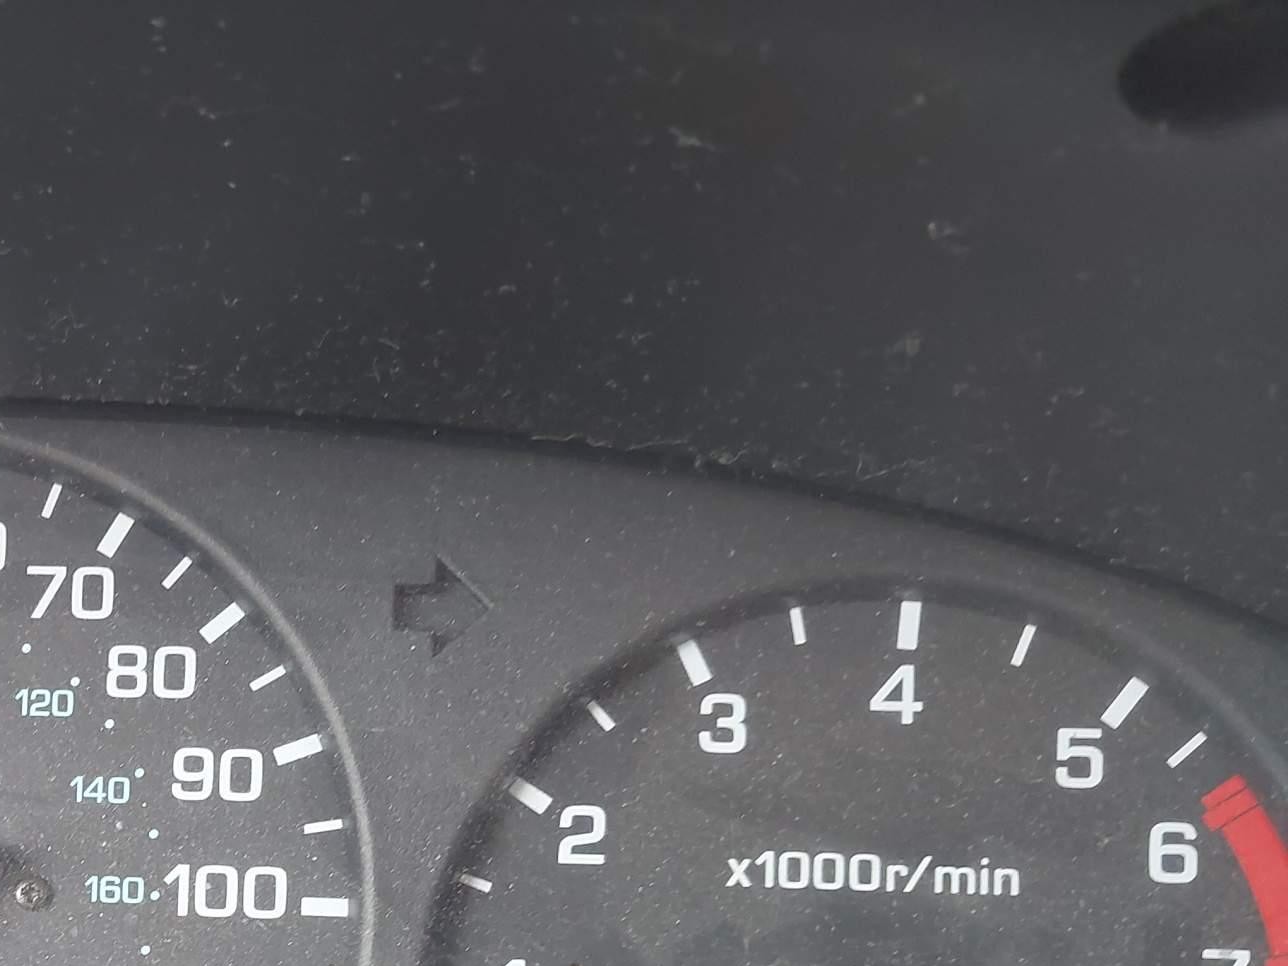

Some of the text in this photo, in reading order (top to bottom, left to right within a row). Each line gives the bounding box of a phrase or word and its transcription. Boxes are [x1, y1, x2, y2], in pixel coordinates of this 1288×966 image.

[26, 565, 115, 620] 70
[106, 644, 197, 699] 80
[869, 664, 924, 725] 4
[15, 688, 74, 717] 120
[698, 693, 747, 754] 3
[171, 747, 263, 802] 90
[1055, 727, 1104, 789] 5
[69, 775, 130, 804] 140
[557, 804, 606, 865] 2
[1148, 821, 1198, 884] 6
[84, 875, 145, 904] 160
[163, 863, 288, 919] 100
